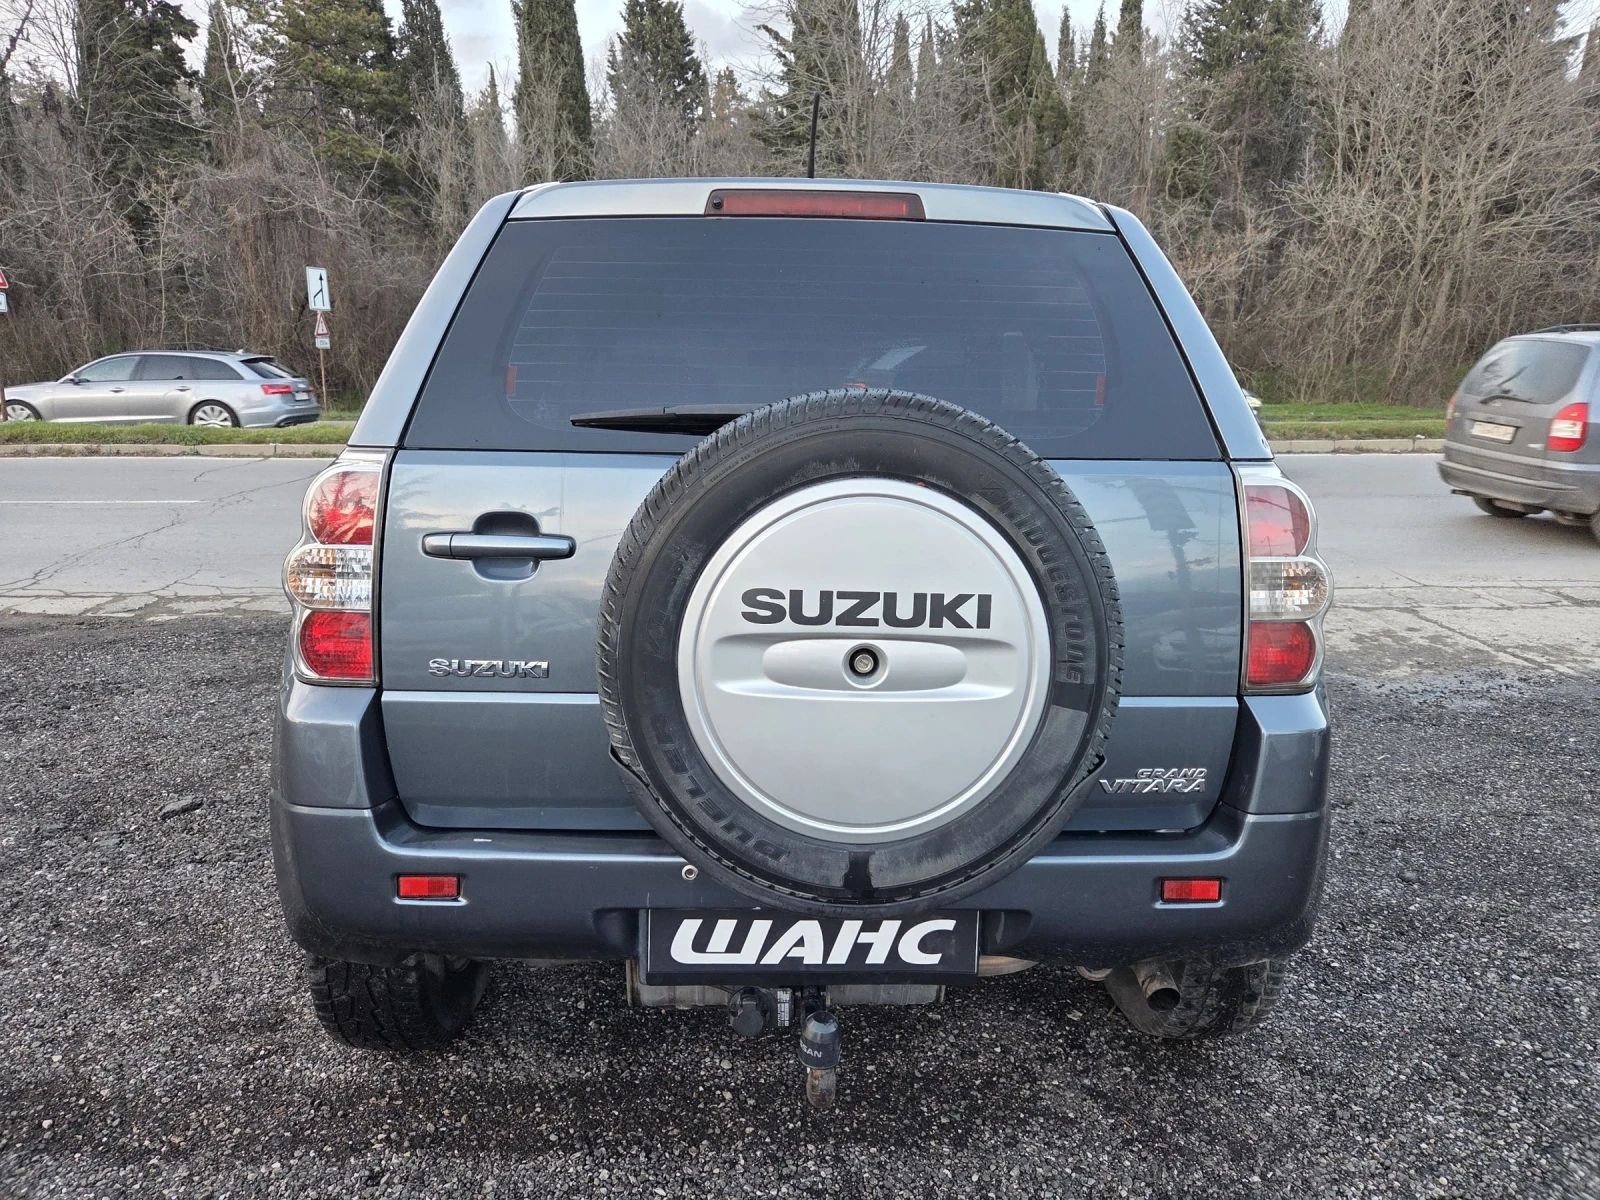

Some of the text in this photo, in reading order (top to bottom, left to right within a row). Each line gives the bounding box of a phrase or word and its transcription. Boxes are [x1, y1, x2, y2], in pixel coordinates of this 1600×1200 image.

[975, 479, 1087, 684] BRIDGESTONE
[741, 588, 992, 629] SUZUKI
[428, 658, 550, 679] SUZUKI
[650, 714, 790, 862] DUELER
[1099, 778, 1206, 794] VITARA
[1135, 767, 1208, 779] GRAND
[670, 919, 957, 965] ШАНС
